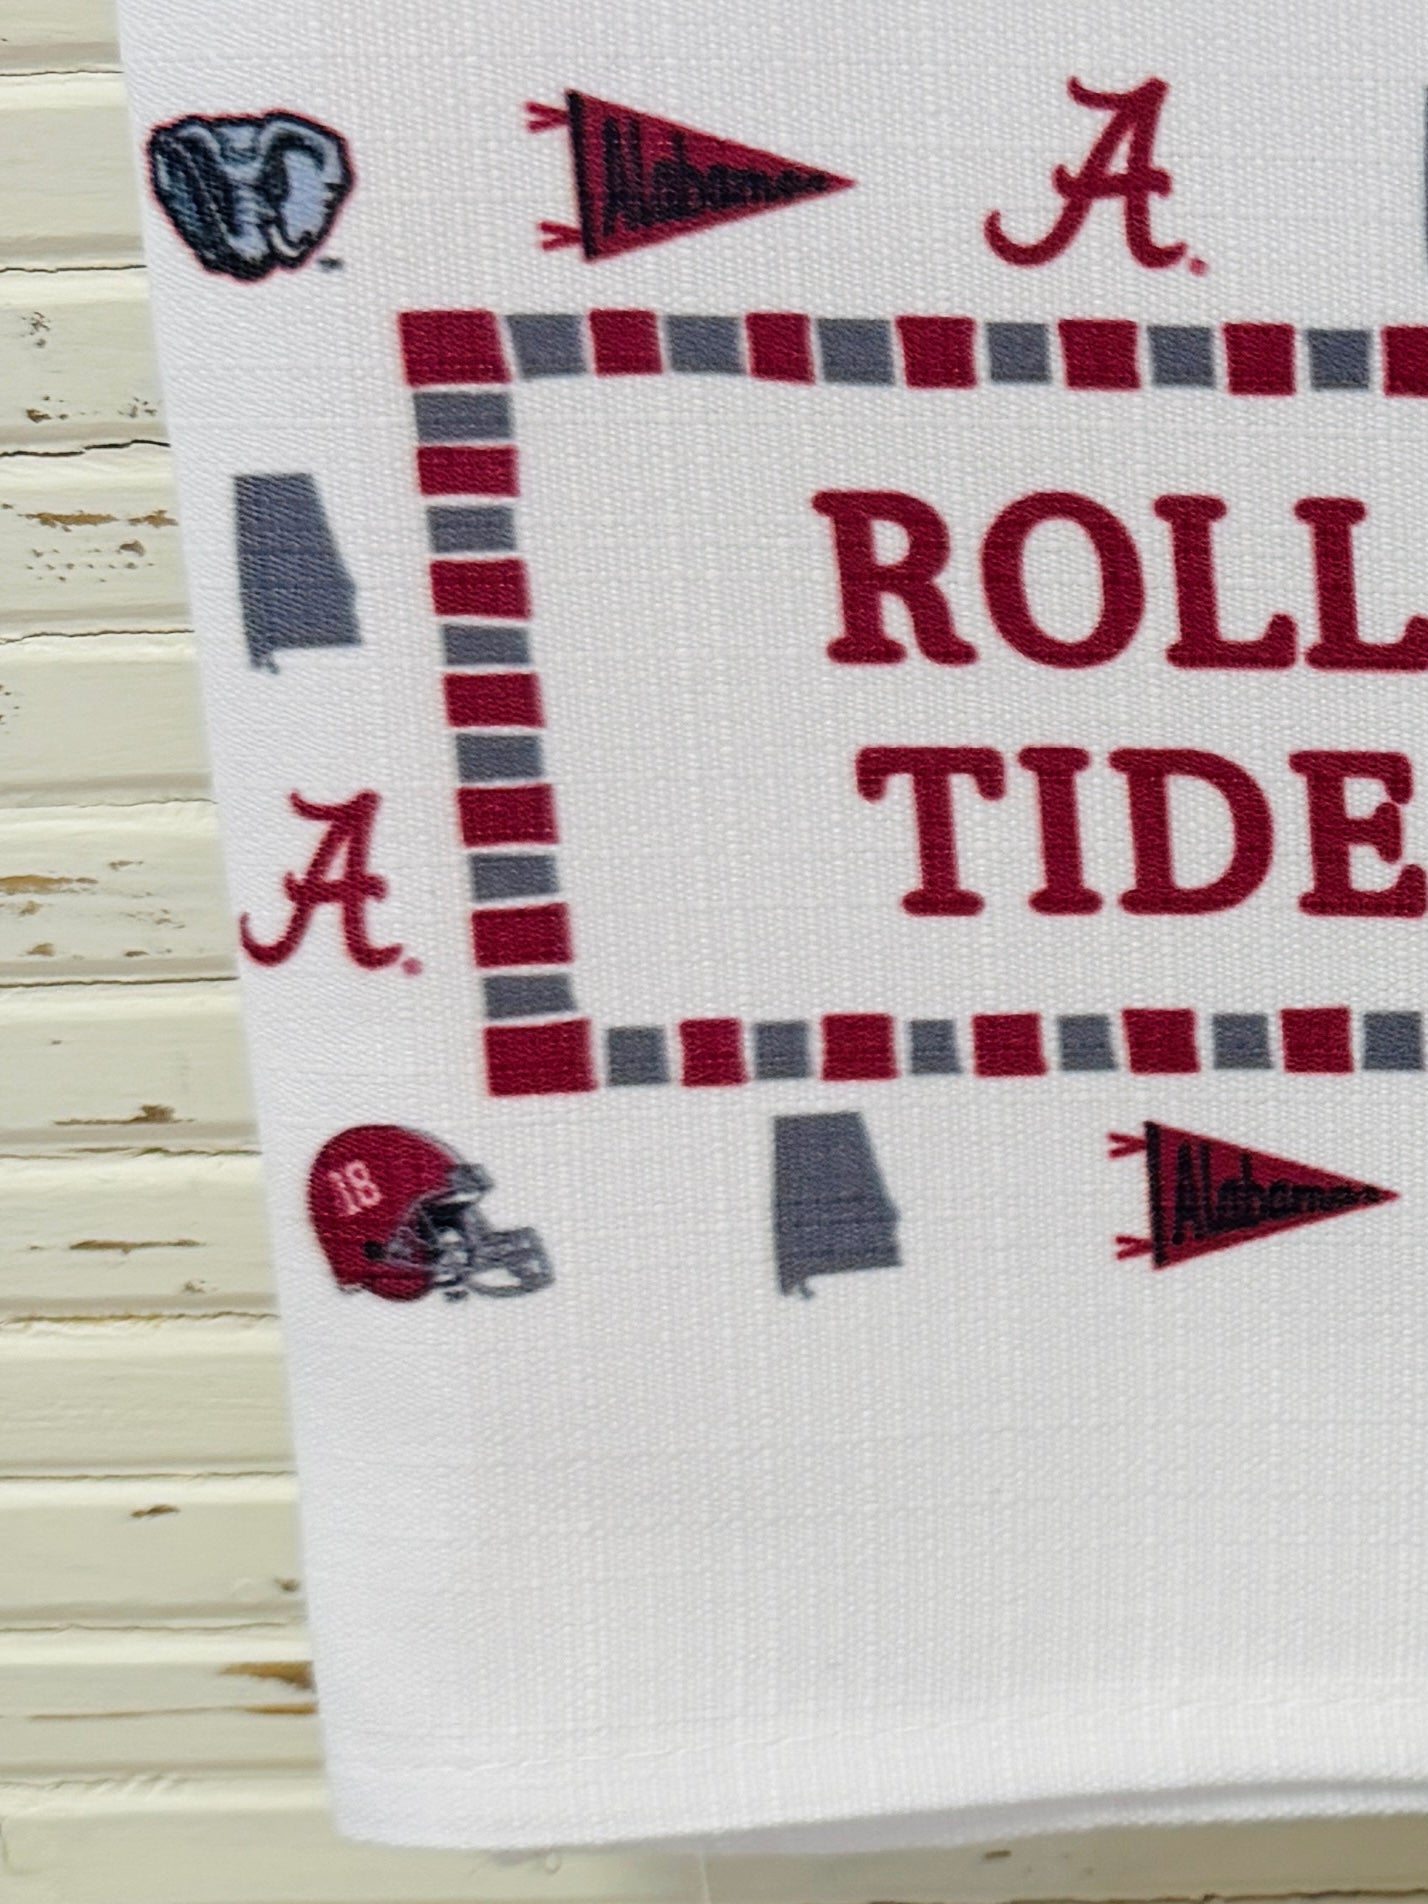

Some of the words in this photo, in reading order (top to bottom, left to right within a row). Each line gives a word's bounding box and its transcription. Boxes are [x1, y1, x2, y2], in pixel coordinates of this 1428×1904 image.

[984, 78, 1188, 270] A
[242, 791, 402, 970] A
[855, 746, 1428, 919] TIDE
[327, 1159, 383, 1216] 18
